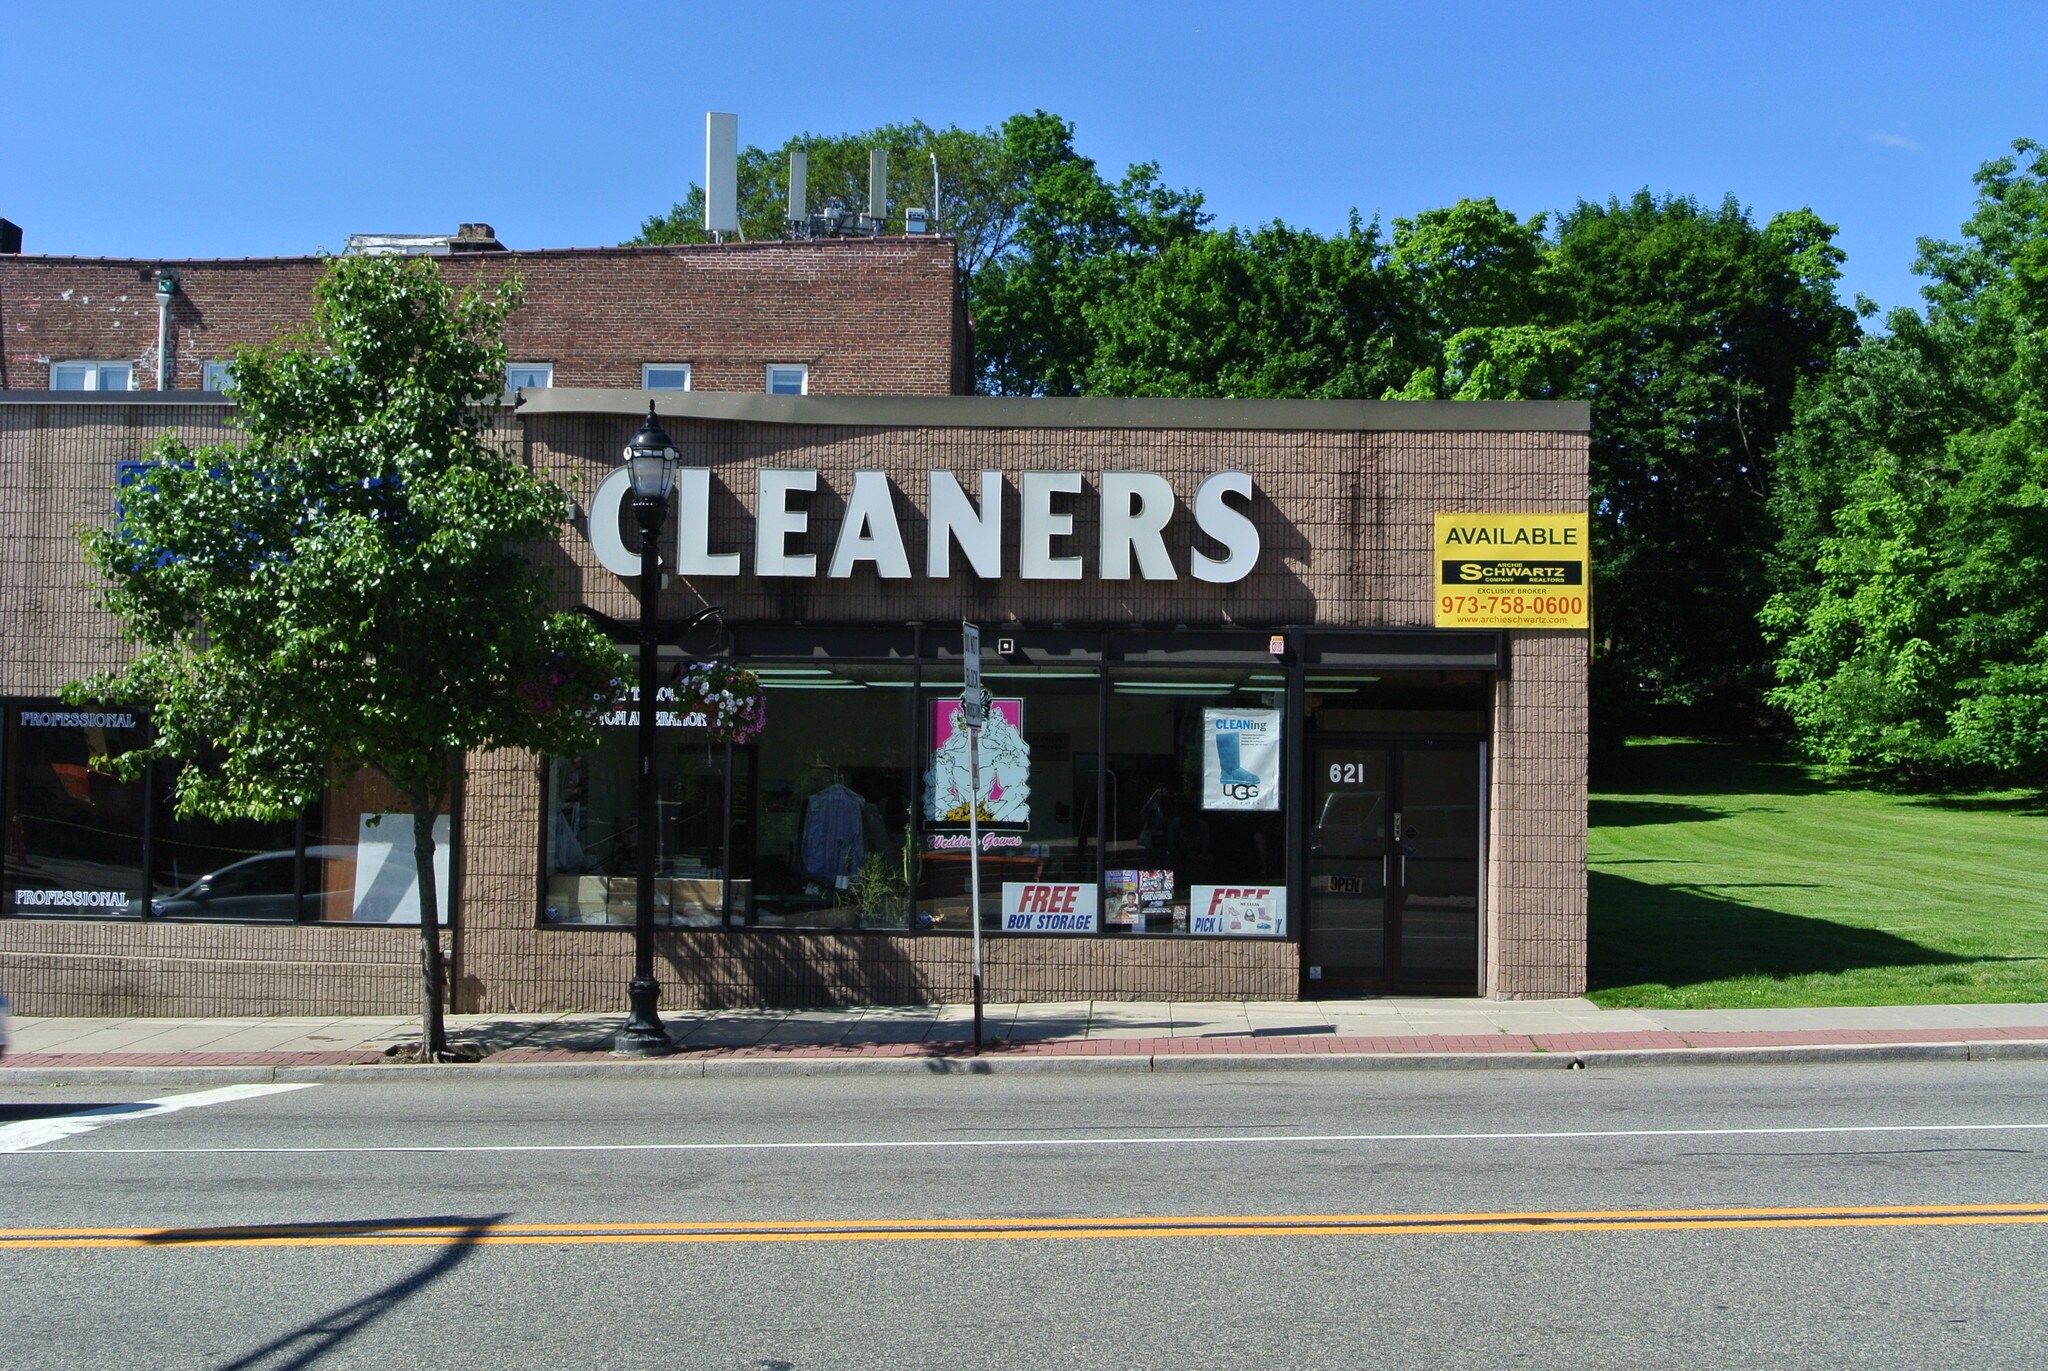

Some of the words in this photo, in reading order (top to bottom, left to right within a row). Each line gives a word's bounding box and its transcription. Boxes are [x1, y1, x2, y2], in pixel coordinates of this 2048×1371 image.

[587, 466, 1260, 584] CLEANERS
[1445, 527, 1578, 545] AVAILABLE
[1459, 563, 1565, 581] SCHWARTZ
[1442, 596, 1582, 614] 973-758-0600
[1457, 616, 1567, 624] www.archieschwartz.com
[21, 712, 136, 728] PROFESSIONAL
[1215, 719, 1267, 731] CLEANing
[1329, 763, 1364, 783] 621
[1223, 784, 1259, 801] UGG
[927, 834, 980, 849] Weddin
[982, 832, 1023, 851] Gowns
[1330, 876, 1360, 892] OPEN
[15, 890, 130, 907] PROFESSIONAL
[1018, 885, 1080, 913] FREE
[1007, 914, 1032, 929] BOX
[1037, 914, 1092, 930] STORAGE
[1194, 917, 1216, 932] PICK
